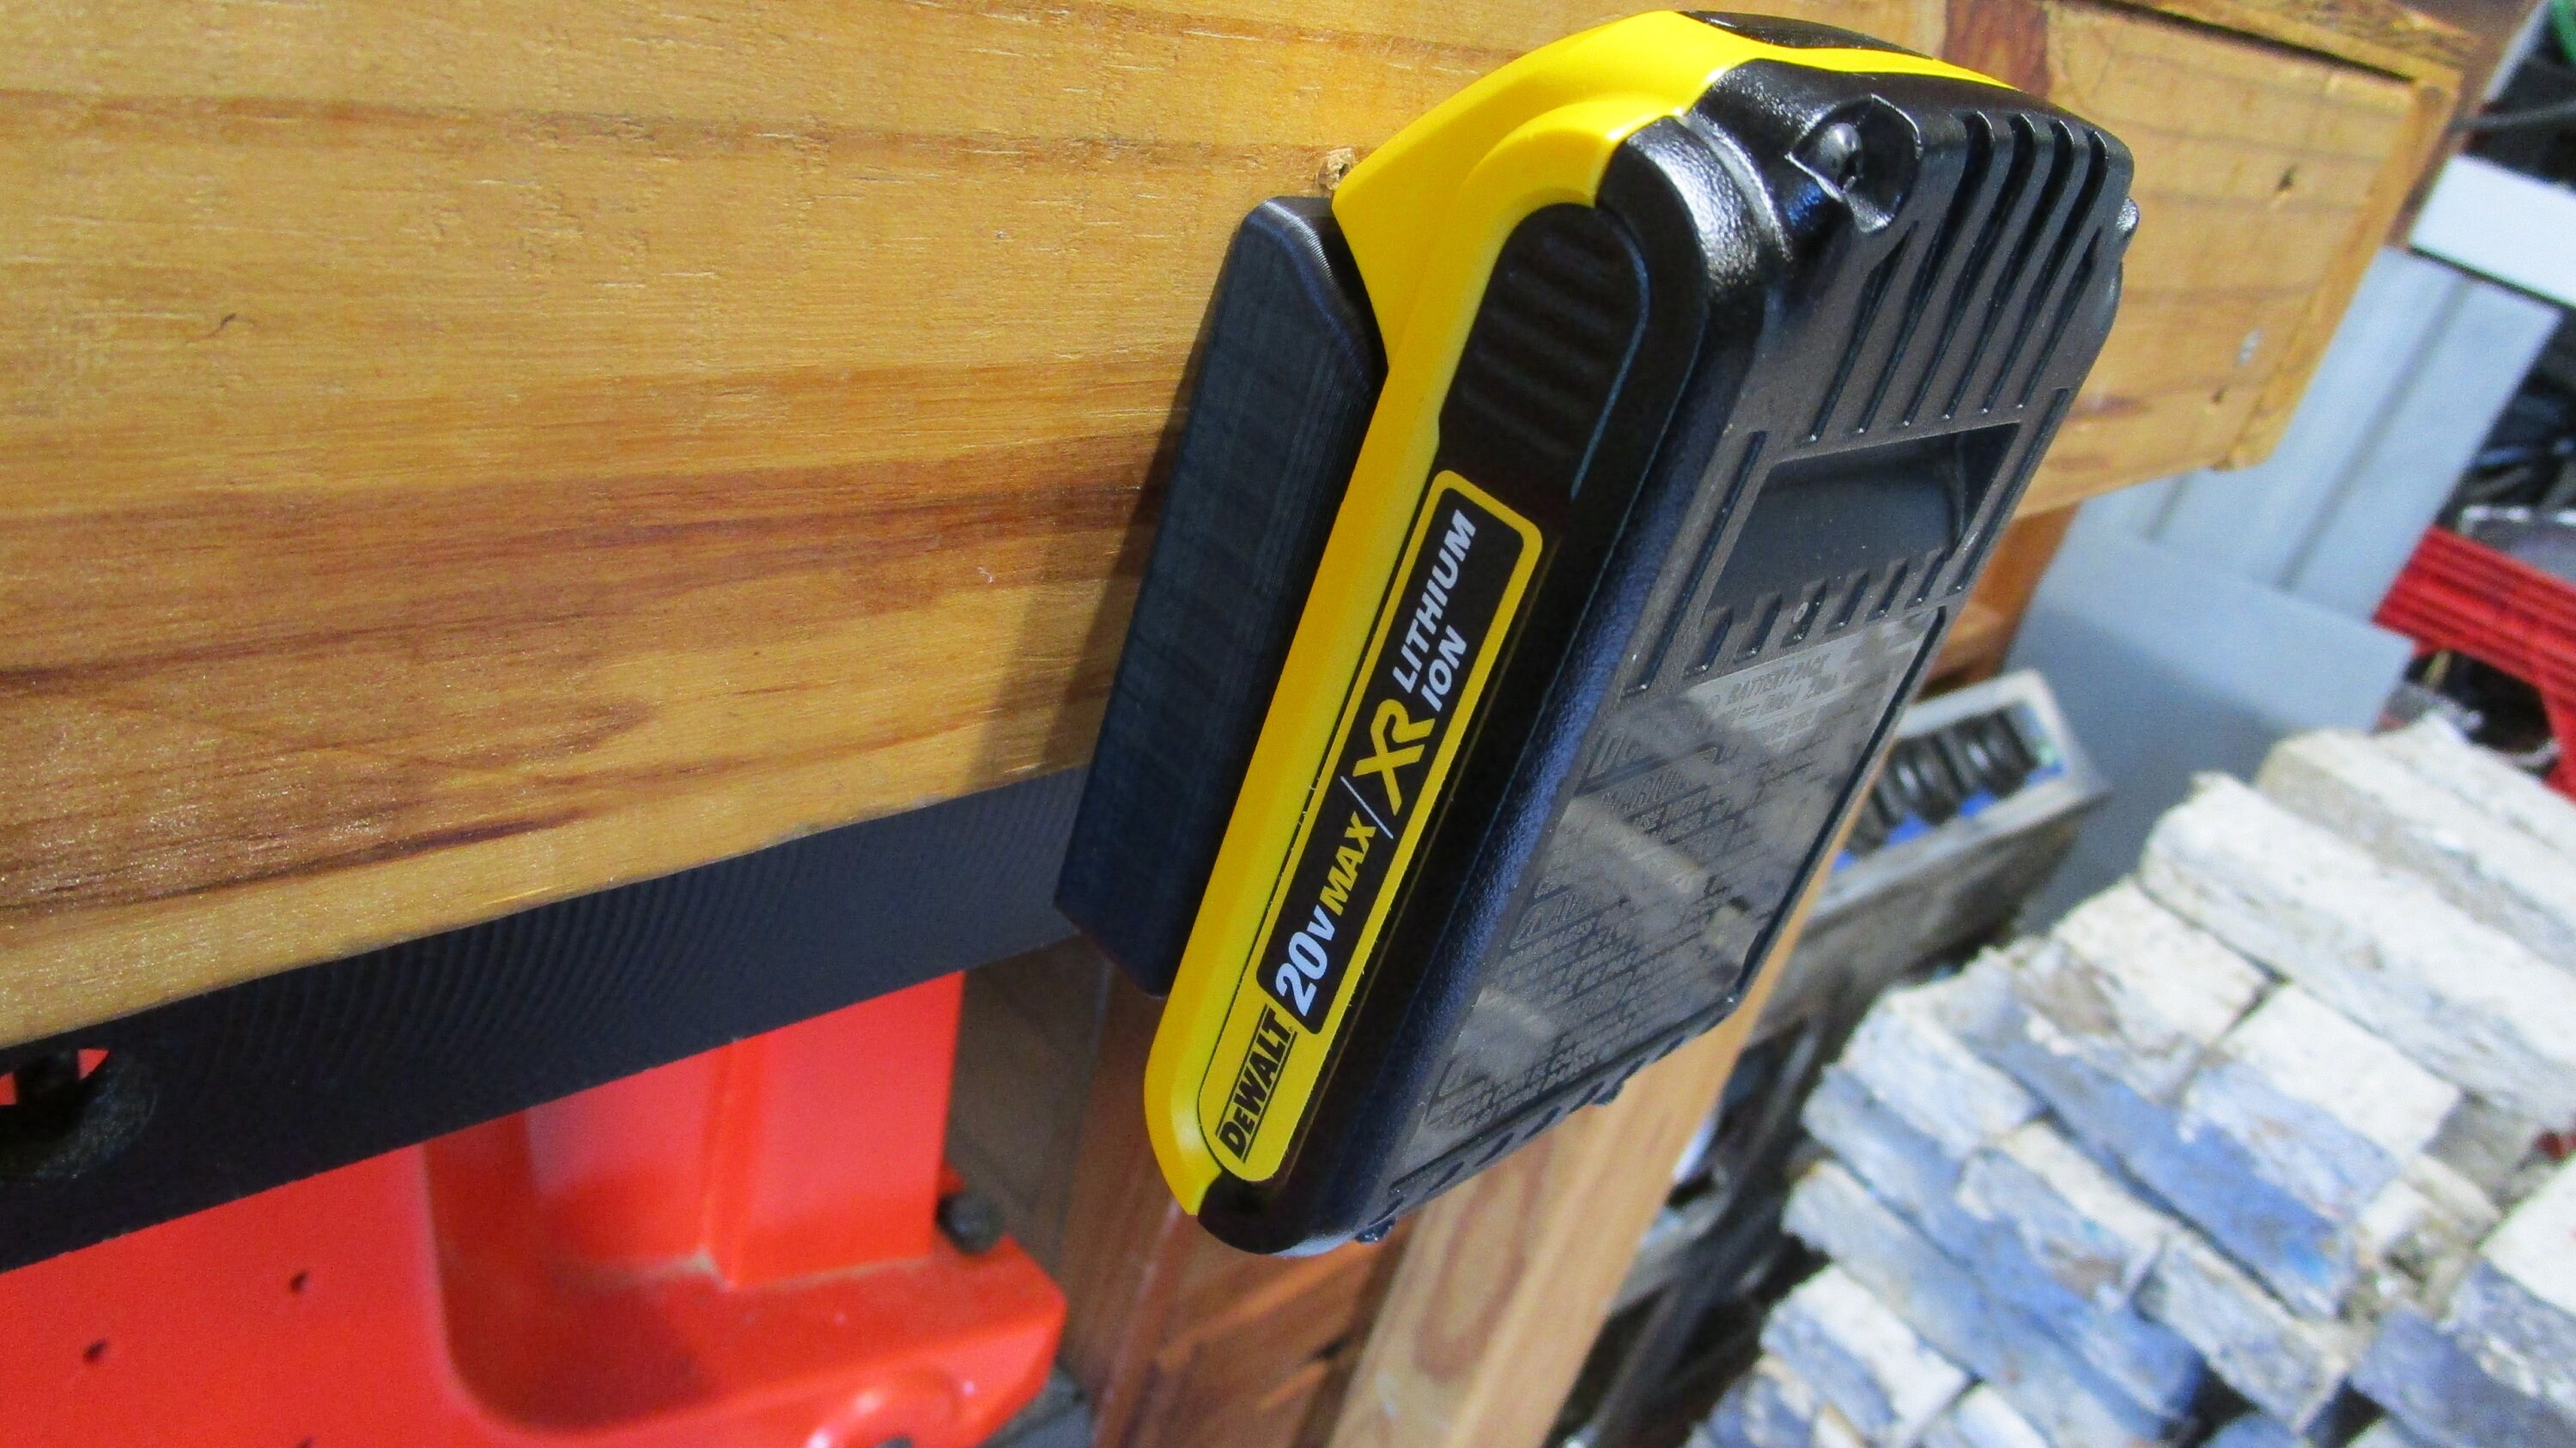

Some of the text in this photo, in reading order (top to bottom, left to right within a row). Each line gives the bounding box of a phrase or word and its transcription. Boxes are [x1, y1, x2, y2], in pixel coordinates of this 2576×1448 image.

[1393, 509, 1477, 693] LITHIUM
[1421, 624, 1467, 712] ION
[1352, 698, 1436, 816] XR
